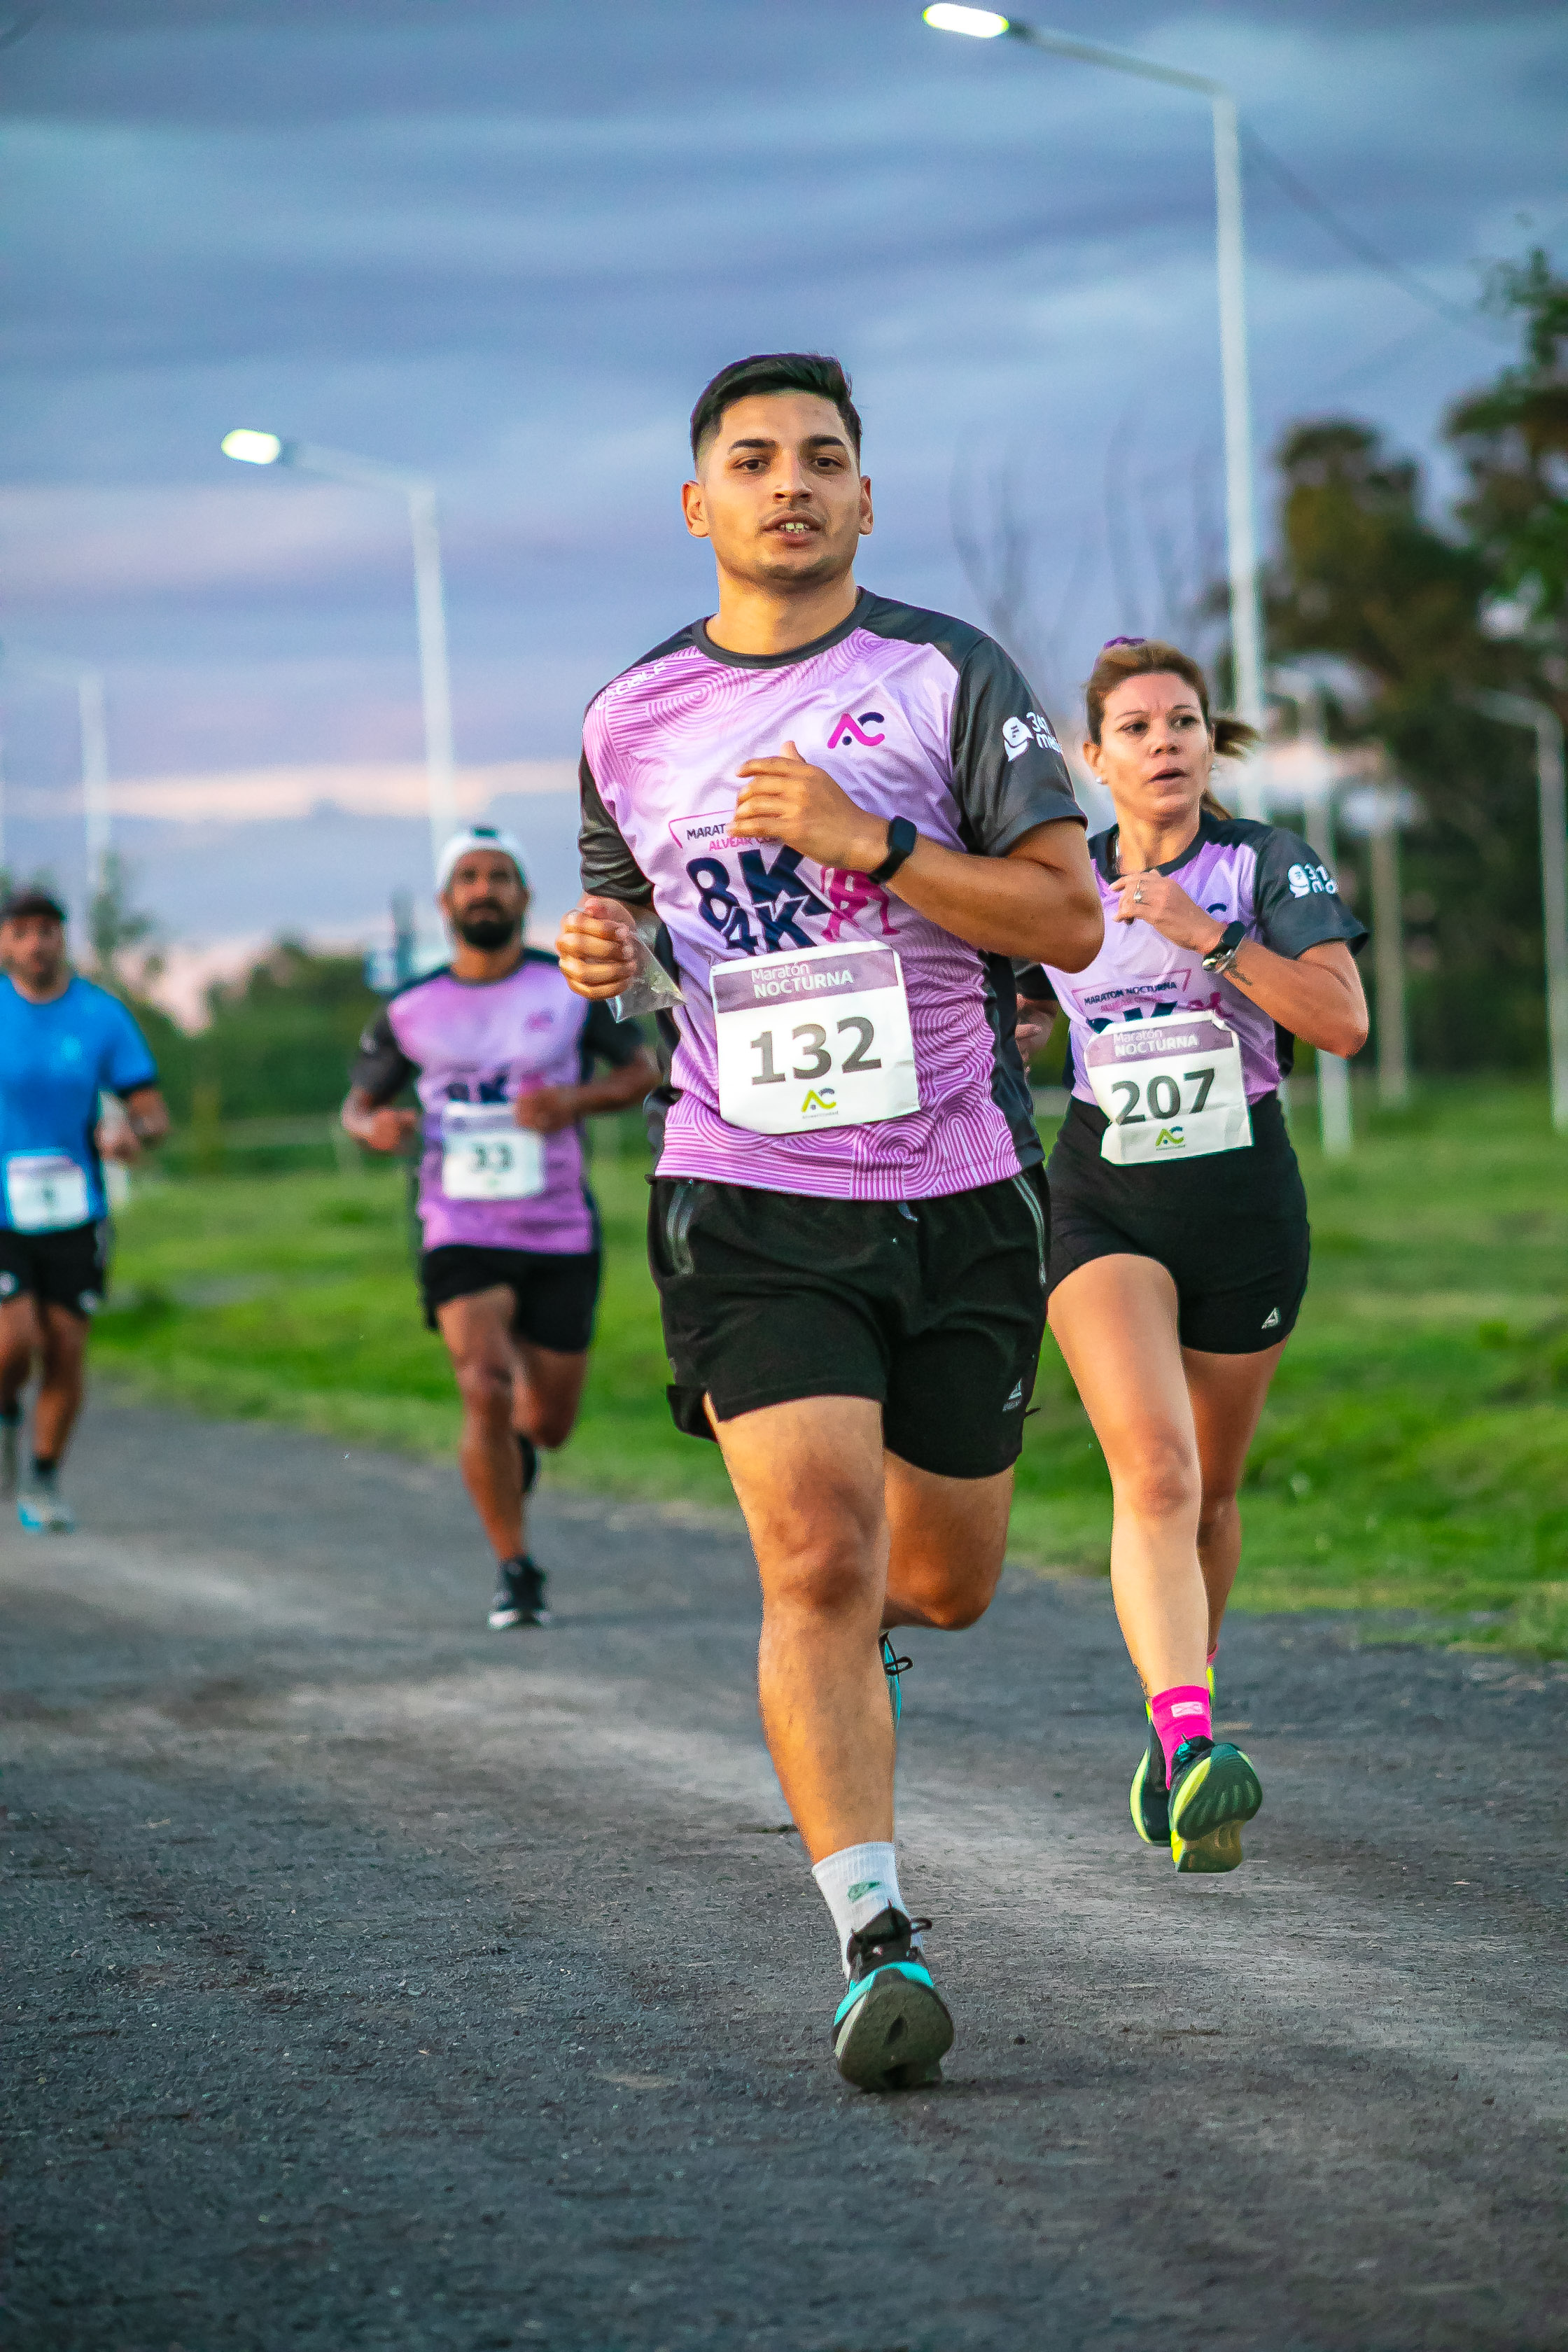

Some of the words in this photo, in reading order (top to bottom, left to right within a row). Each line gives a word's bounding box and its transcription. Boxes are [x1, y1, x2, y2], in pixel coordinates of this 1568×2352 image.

[687, 823, 727, 840] MARAT
[751, 962, 811, 983] Maratón
[753, 969, 854, 999] NOCTURNA
[1113, 1029, 1163, 1044] Maratón
[1114, 1035, 1198, 1057] NOCTURNA
[750, 1016, 882, 1086] 132
[1111, 1068, 1215, 1126] 207
